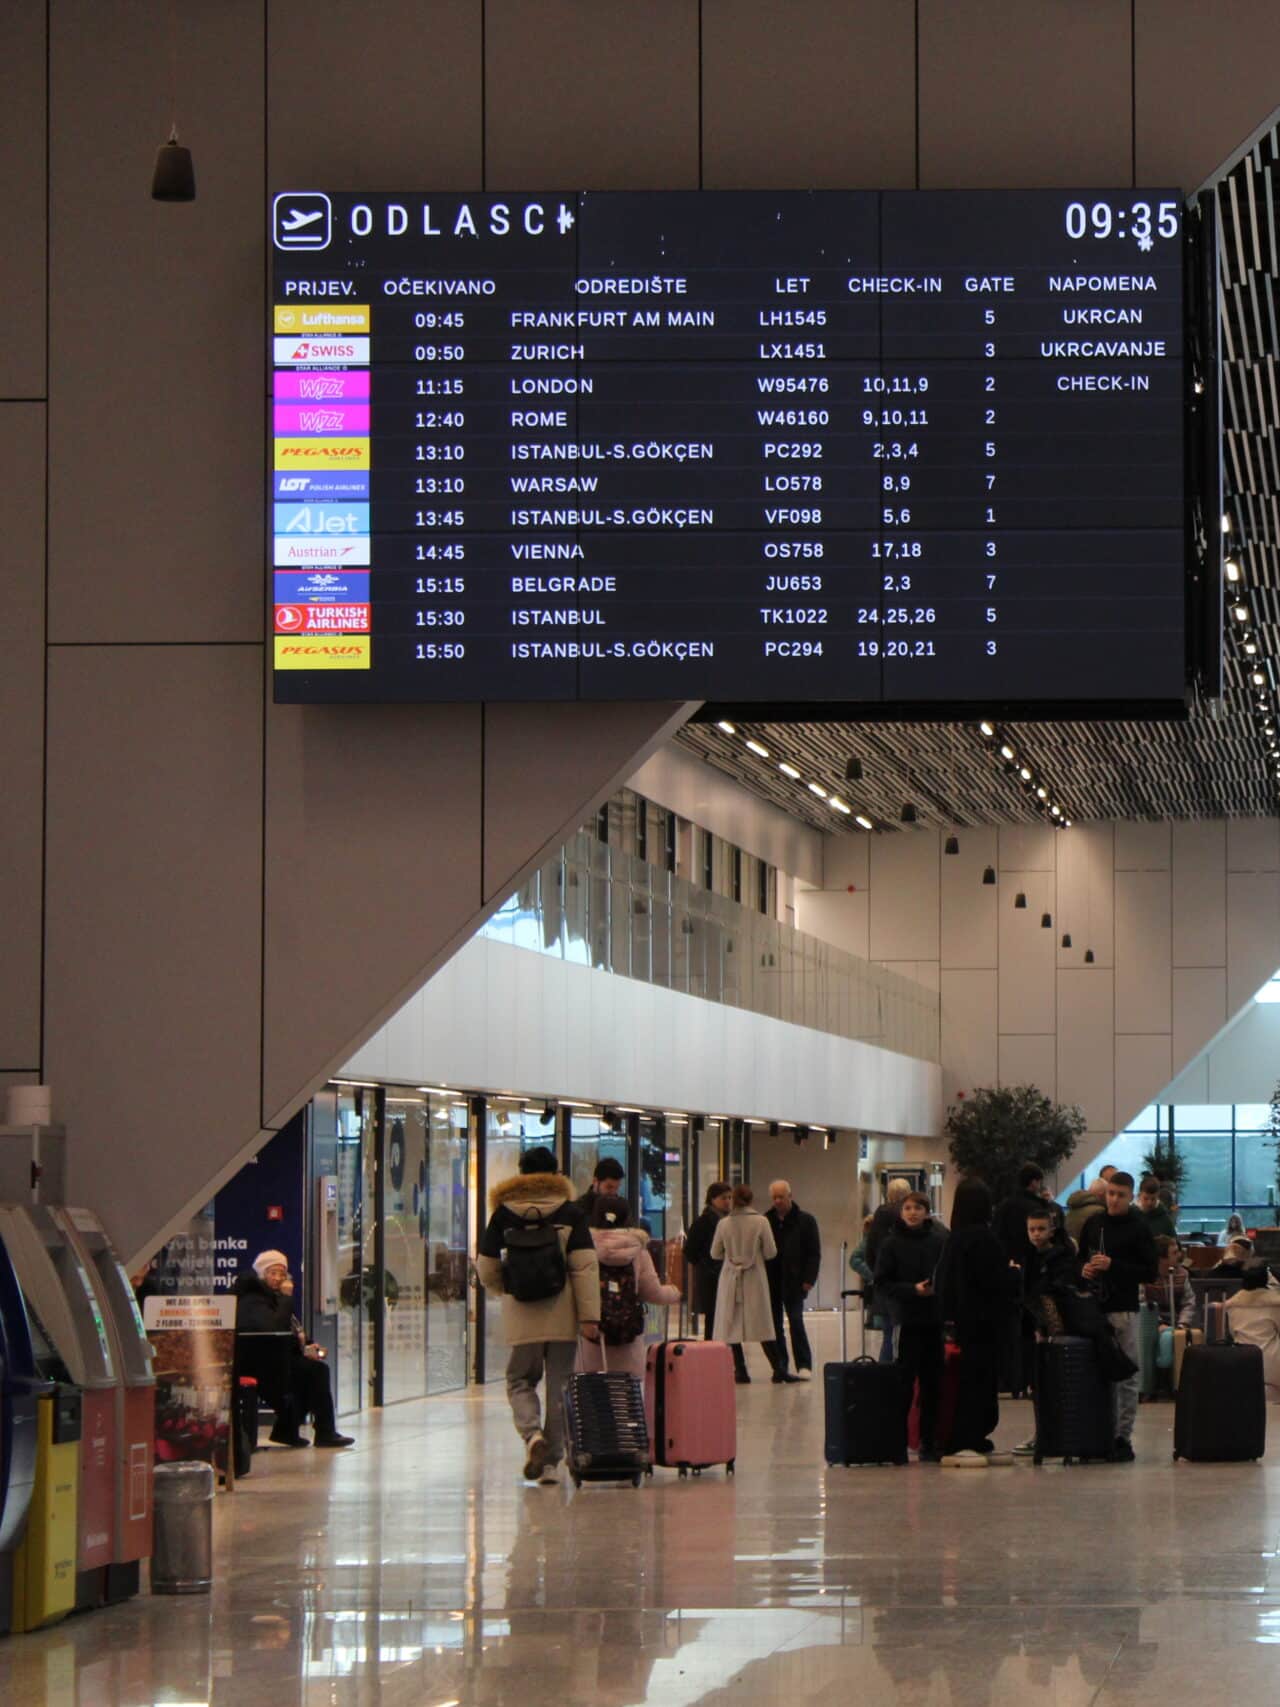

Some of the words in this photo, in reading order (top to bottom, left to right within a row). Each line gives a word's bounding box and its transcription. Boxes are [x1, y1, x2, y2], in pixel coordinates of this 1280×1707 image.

[1066, 201, 1178, 239] 09:35
[285, 281, 357, 296] PRIJEV.
[383, 276, 496, 296] OČEKIVANO
[576, 275, 687, 295] ODREDIŠTE
[775, 277, 811, 294] LET
[848, 278, 942, 293] CHECK-IN
[965, 276, 1015, 293] GATE
[1048, 275, 1157, 291] NAPOMENA
[414, 312, 465, 328] 09:45
[511, 311, 628, 328] FRANKFURT
[633, 312, 662, 327] AM
[667, 311, 715, 327] MAIN
[759, 310, 827, 326] LH1545
[984, 310, 996, 325] 5
[1063, 308, 1143, 324] UKRCAN
[311, 345, 354, 357] SWISS
[414, 345, 465, 361] 09:50
[511, 344, 585, 360] ZURICH
[759, 343, 827, 359] LX1451
[984, 343, 996, 358] 3
[1041, 341, 1166, 358] UKRCAVANJE
[416, 379, 464, 395] 11:15
[510, 378, 593, 394] LONDON
[757, 377, 829, 393] W95476
[863, 377, 929, 395] 10,11,9
[985, 377, 996, 392] 2
[1057, 375, 1150, 391] CHECK-IN
[415, 412, 465, 428] 12:40
[510, 411, 568, 427] ROME
[757, 410, 829, 426] W46160
[862, 410, 929, 427] 9,10,11
[985, 409, 996, 425] 2
[415, 445, 465, 461] 13:10
[511, 441, 713, 463] ISTANBUL-S.GÖKÇEN
[764, 443, 823, 459] PC292
[873, 443, 919, 460] 2,3,4
[985, 442, 996, 457] 5
[415, 478, 465, 494] 13:10
[510, 477, 599, 493] WARSAW
[764, 476, 823, 492] LO578
[882, 476, 911, 493] 8,9
[985, 475, 996, 490] 7
[415, 510, 465, 527] 13:45
[511, 507, 714, 529] ISTANBUL-S.GÖKÇEN
[764, 509, 822, 524] VF098
[883, 509, 911, 526] 5,6
[986, 508, 996, 523] 1
[288, 546, 337, 558] Austrian
[415, 544, 465, 561] 14:45
[511, 543, 585, 560] VIENNA
[764, 542, 824, 559] OS758
[872, 542, 922, 560] 17,18
[985, 542, 997, 557] 3
[415, 577, 465, 594] 15:15
[511, 576, 617, 593] BELGRADE
[765, 575, 822, 591] JU653
[883, 576, 911, 592] 2,3
[986, 575, 997, 590] 7
[306, 607, 368, 619] TURKISH
[415, 610, 465, 626] 15:30
[511, 610, 606, 626] ISTANBUL
[760, 608, 828, 624] TK1022
[857, 608, 936, 625] 24,25,26
[986, 608, 997, 623] 5
[306, 618, 368, 629] AIRLINES
[415, 643, 465, 660] 15:50
[511, 639, 714, 661] ISTANBUL-S.GÖKÇEN
[764, 642, 824, 657] PC294
[857, 641, 936, 658] 19,20,21
[986, 641, 997, 656] 3
[217, 1257, 239, 1268] na
